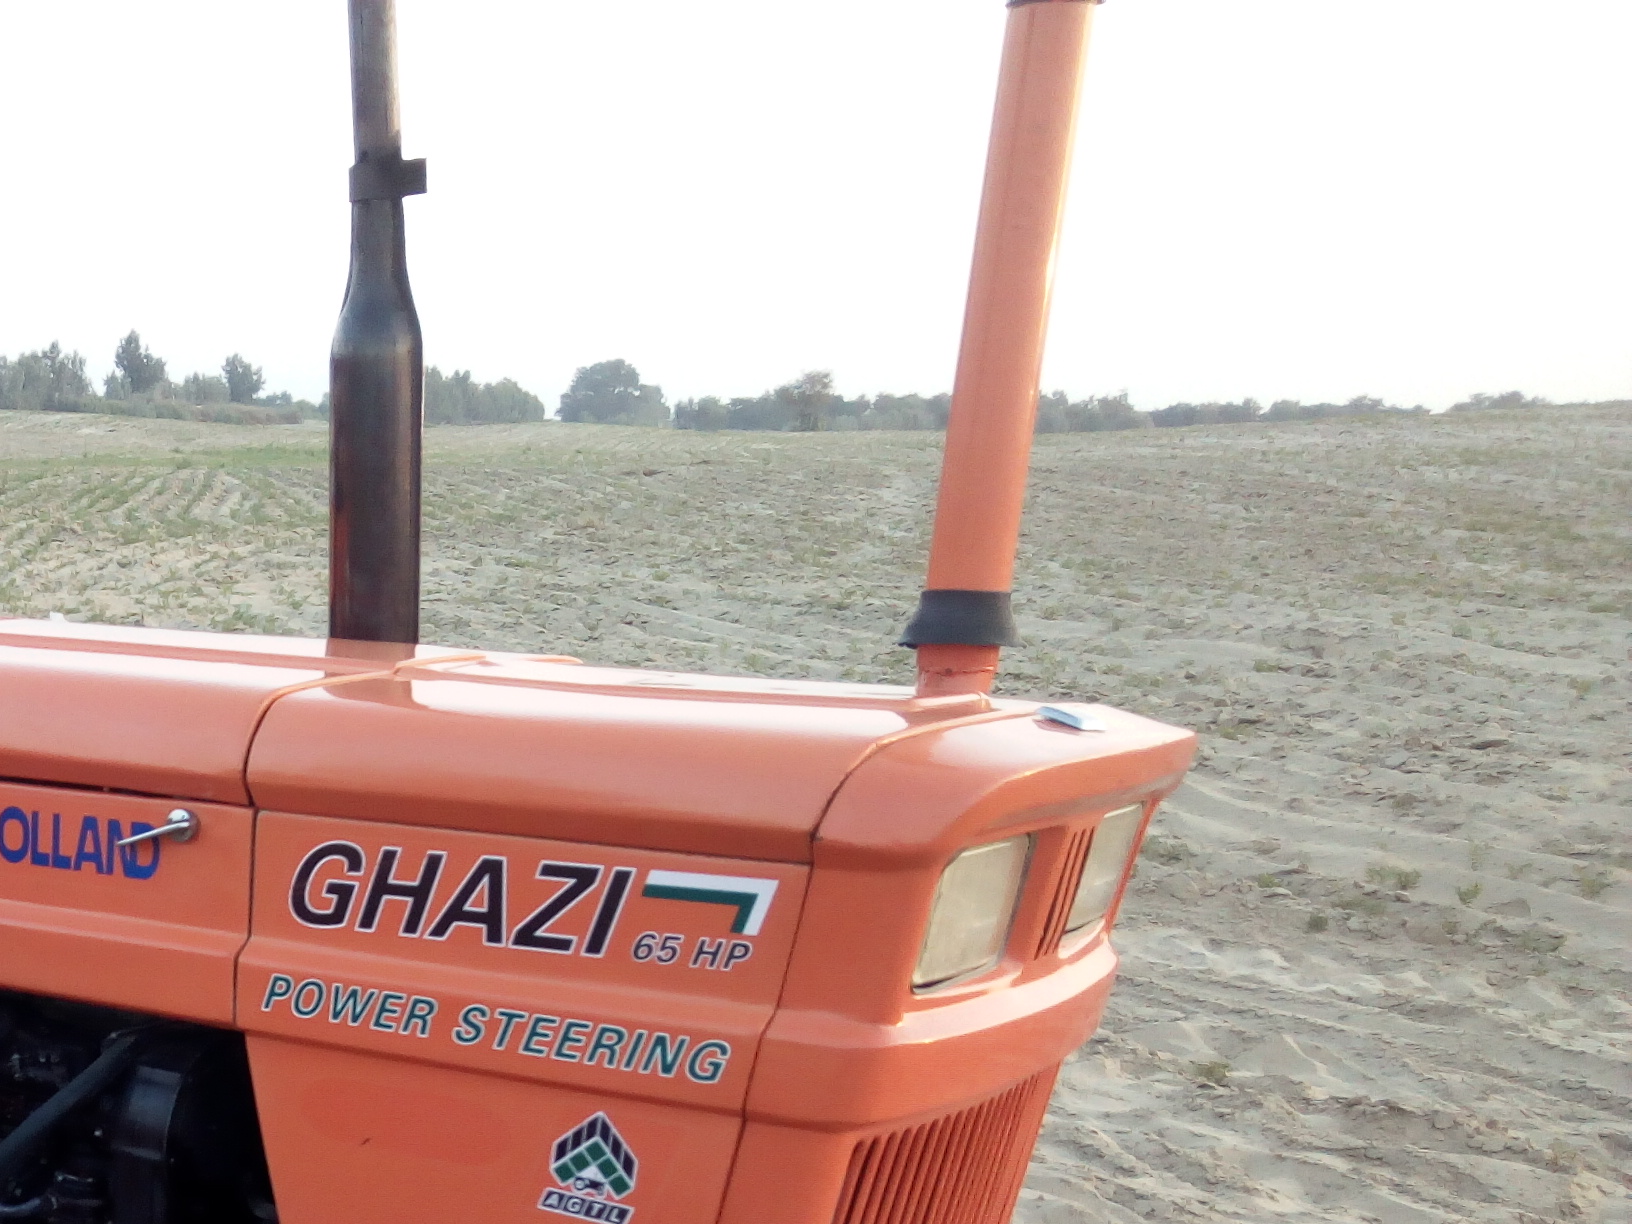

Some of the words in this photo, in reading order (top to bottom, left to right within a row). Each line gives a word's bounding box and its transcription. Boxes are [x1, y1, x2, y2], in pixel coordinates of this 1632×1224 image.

[288, 839, 637, 957] GHAZI
[632, 932, 685, 964] 65
[688, 938, 752, 972] HP
[261, 974, 438, 1038] POWER
[451, 1003, 733, 1085] STEERING
[543, 1192, 628, 1224] AGTL
